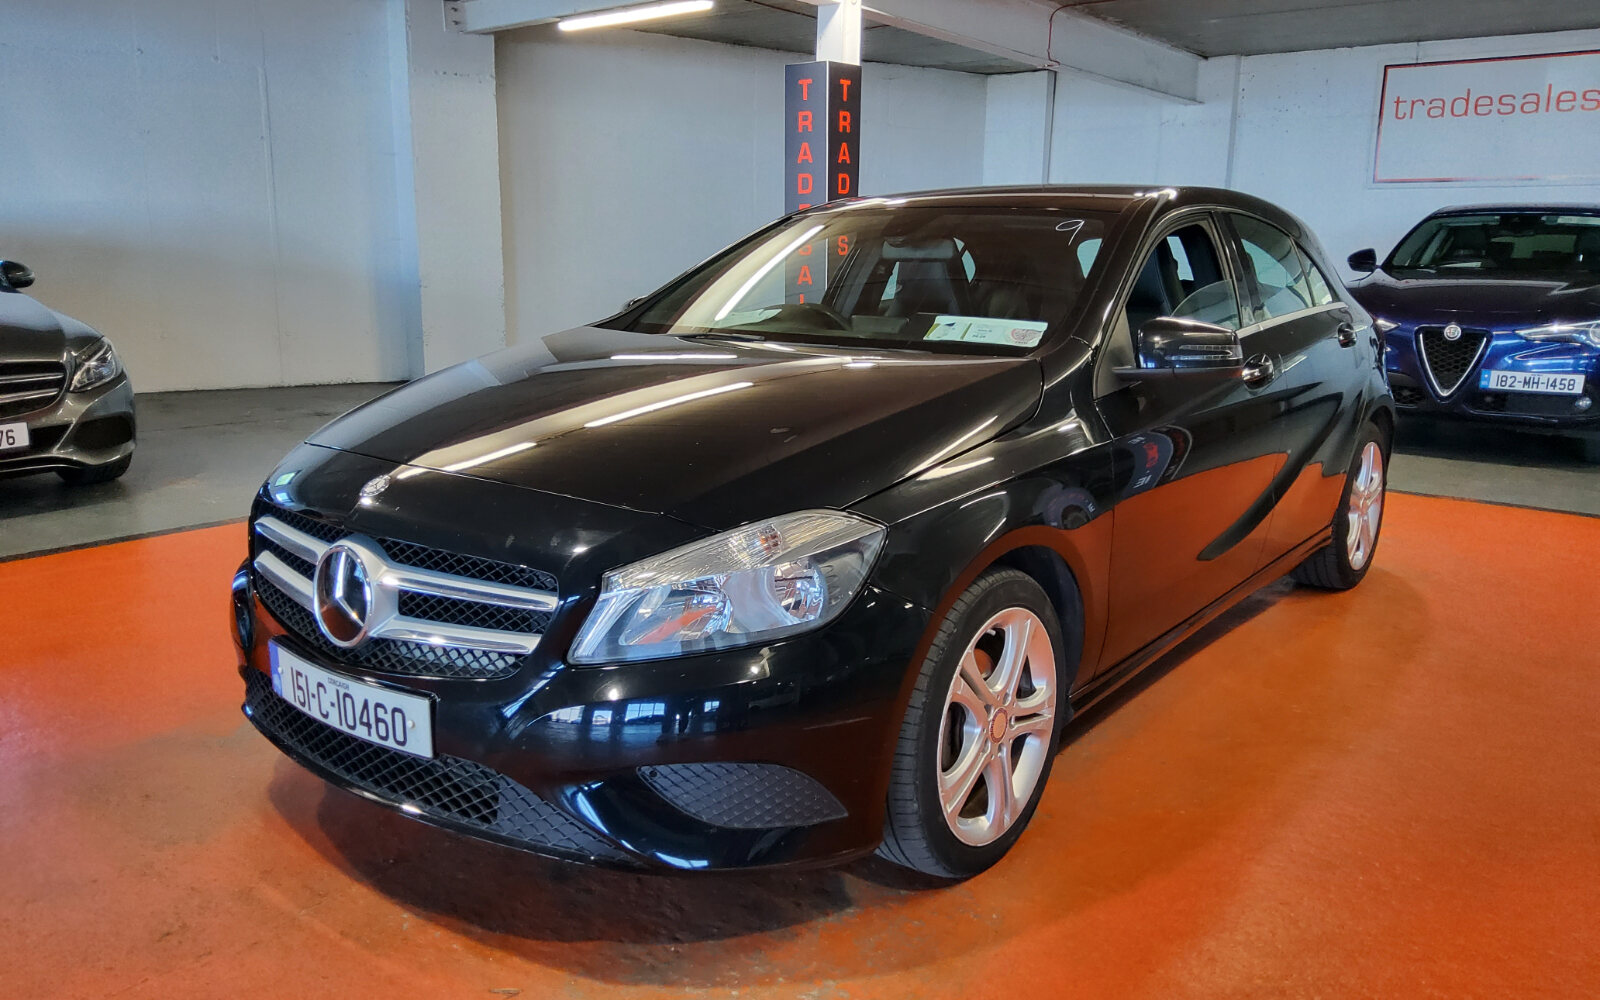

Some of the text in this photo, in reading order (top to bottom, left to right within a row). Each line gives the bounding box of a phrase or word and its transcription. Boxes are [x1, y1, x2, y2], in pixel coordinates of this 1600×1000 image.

[1393, 83, 1600, 120] tradesales
[1495, 374, 1576, 391] 182-MH-1458
[290, 666, 408, 747] 151-C-10460
